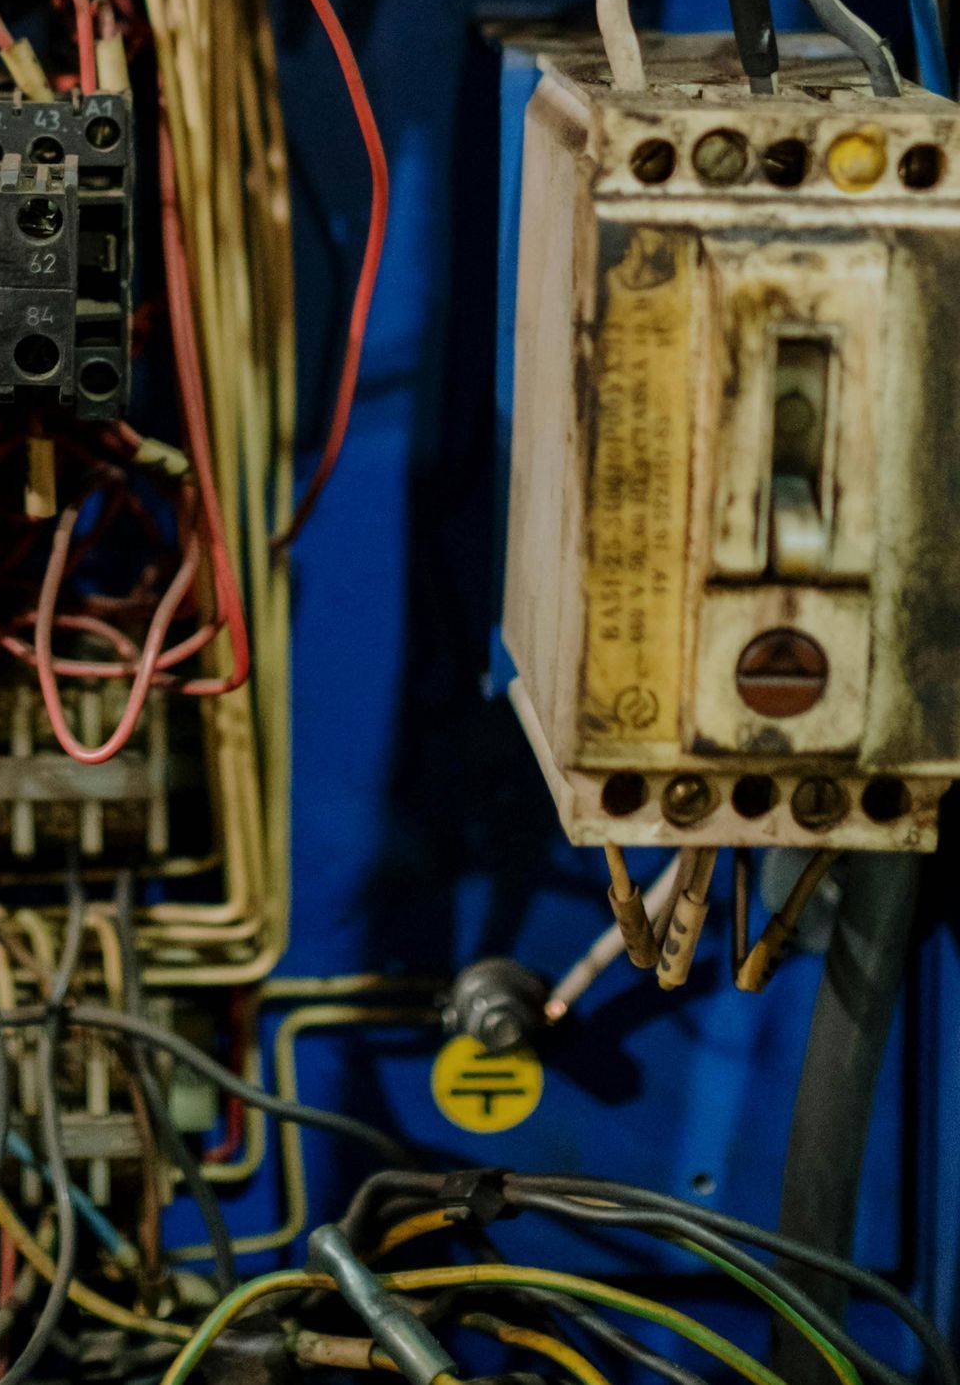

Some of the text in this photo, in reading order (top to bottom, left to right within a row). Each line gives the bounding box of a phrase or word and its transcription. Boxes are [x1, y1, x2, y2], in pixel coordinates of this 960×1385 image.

[34, 109, 60, 132] 43
[85, 98, 113, 117] A1
[28, 253, 56, 274] 62
[25, 307, 54, 326] 84
